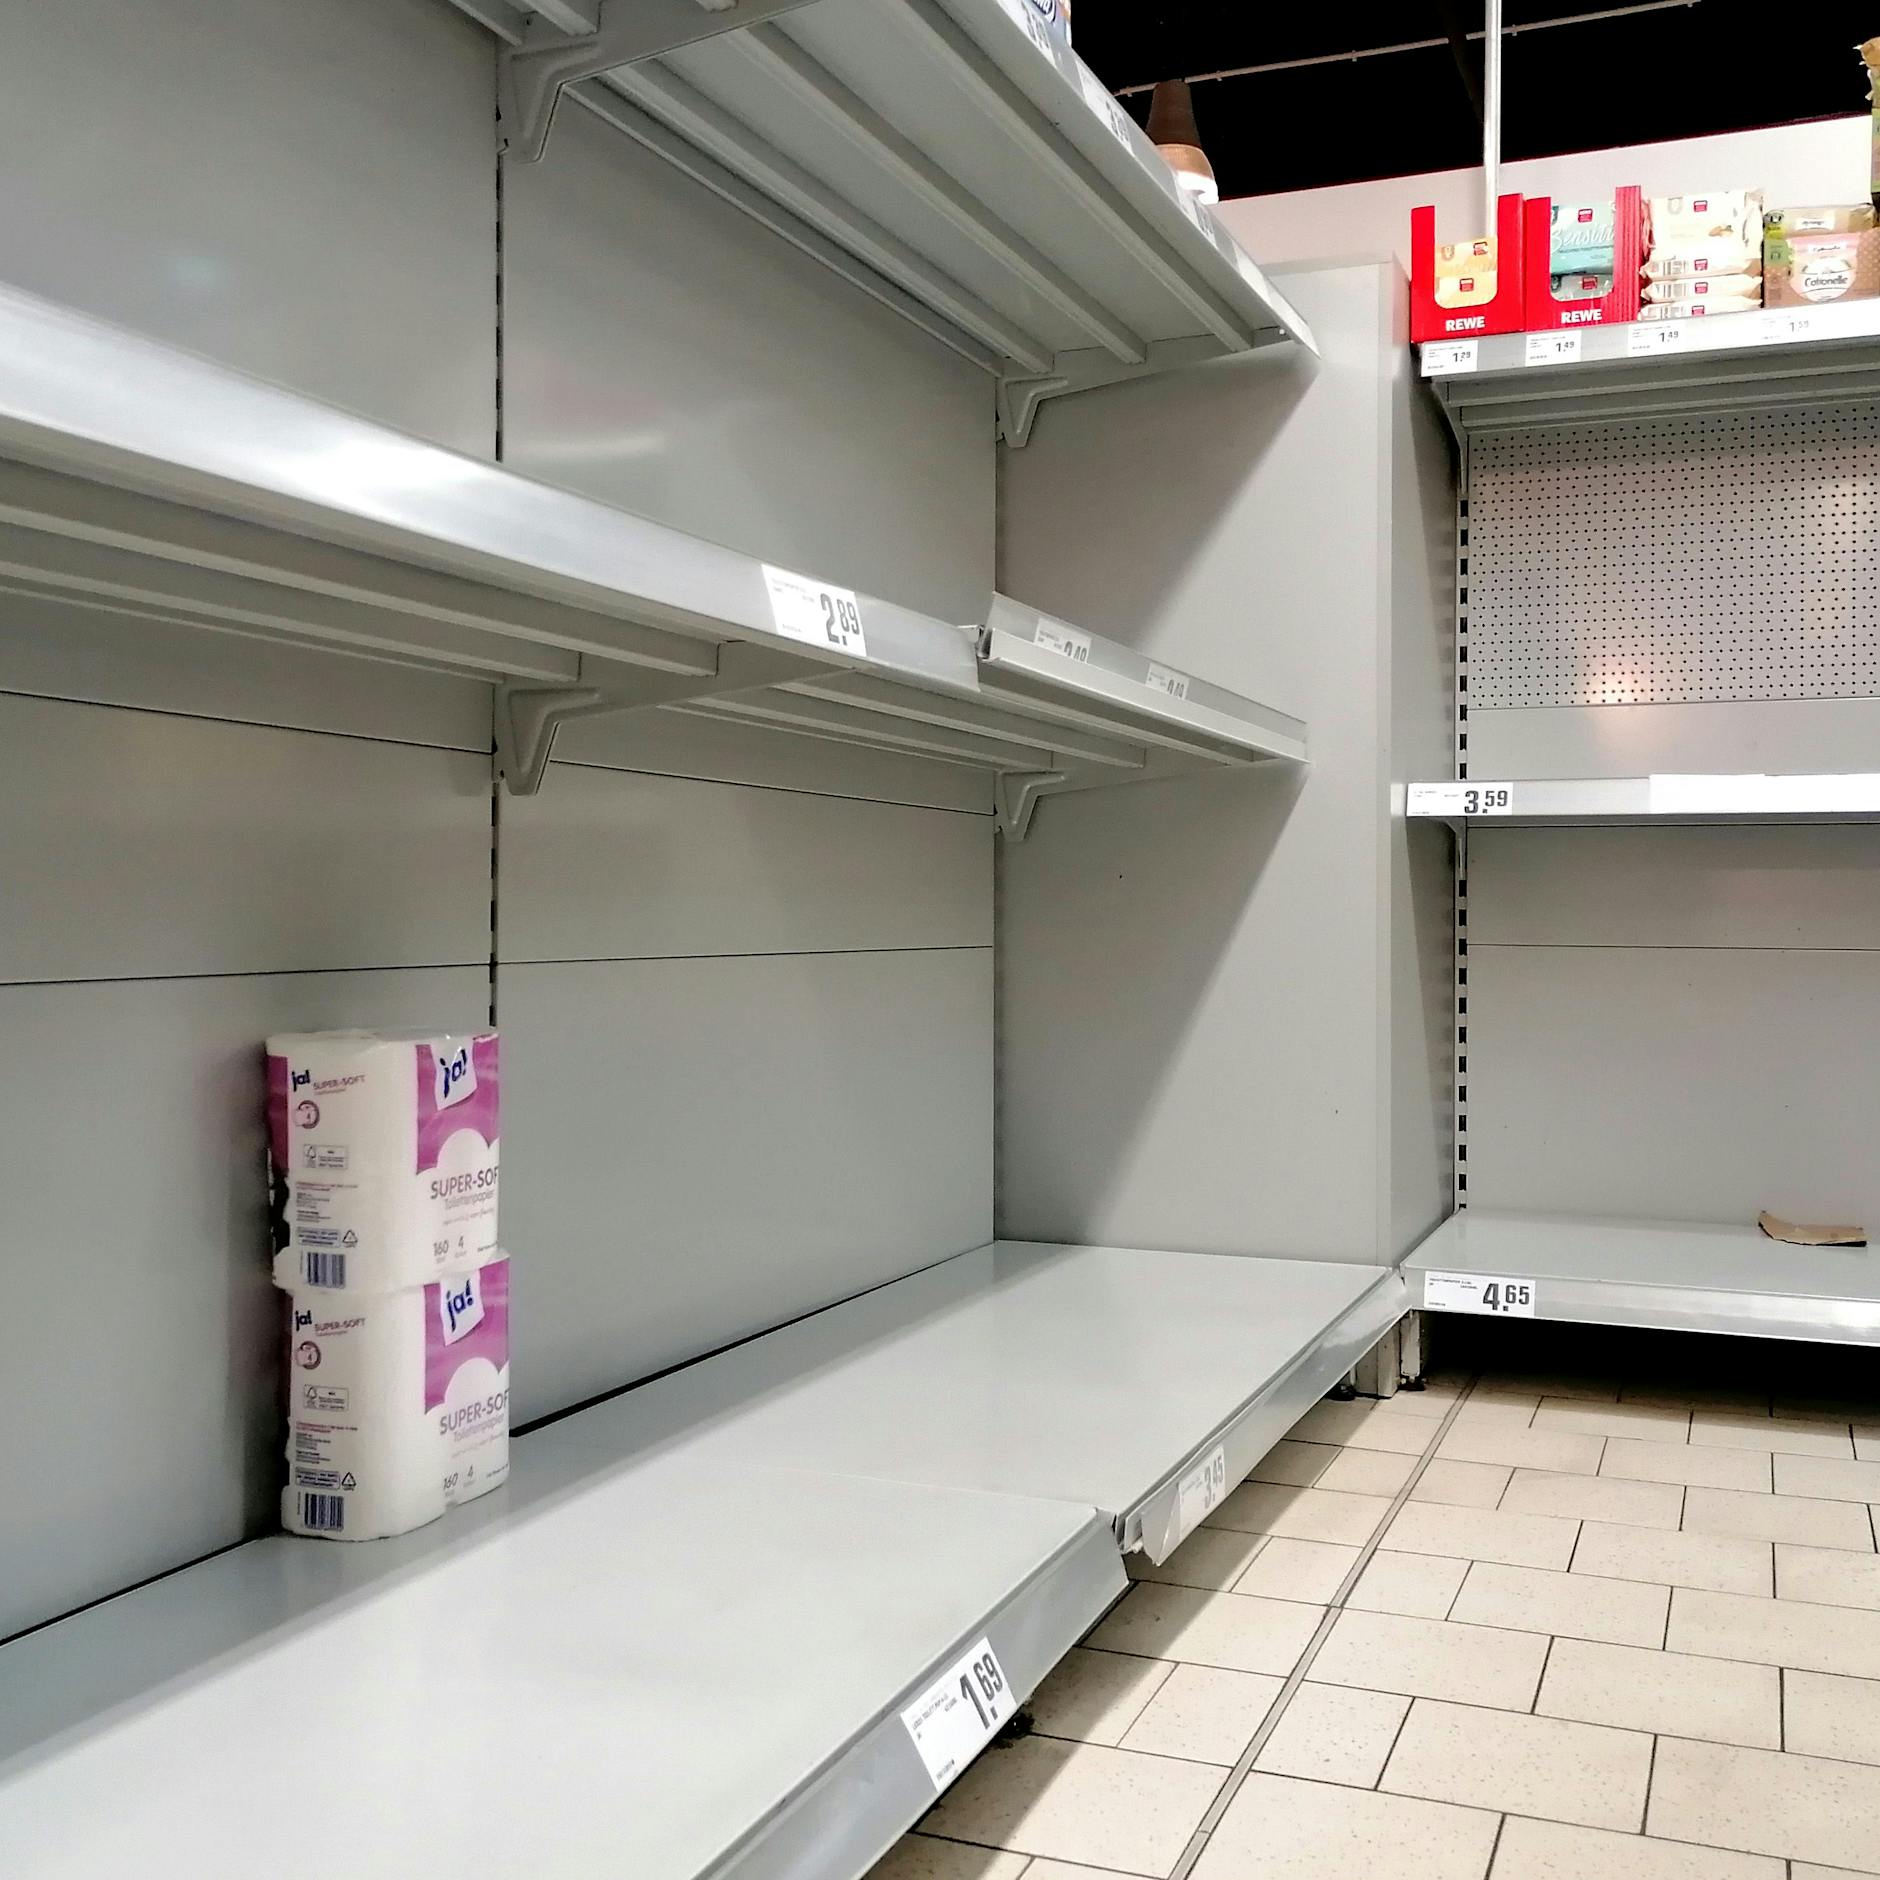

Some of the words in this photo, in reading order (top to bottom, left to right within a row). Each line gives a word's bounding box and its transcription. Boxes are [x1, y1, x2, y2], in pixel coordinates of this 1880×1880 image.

[1445, 315, 1485, 332] REWE
[1561, 308, 1602, 324] REWE
[820, 593, 860, 646] 2.89
[1463, 790, 1508, 814] 3.59
[292, 1069, 311, 1092] ja!
[313, 1074, 366, 1091] SUPER-SOFT
[440, 1048, 467, 1099] ja!
[446, 1279, 474, 1333] ja!
[1482, 1283, 1530, 1312] 4.65
[295, 1310, 312, 1332] ja!
[314, 1317, 366, 1333] SUPER-SOFT
[959, 1652, 1004, 1730] 1.69
